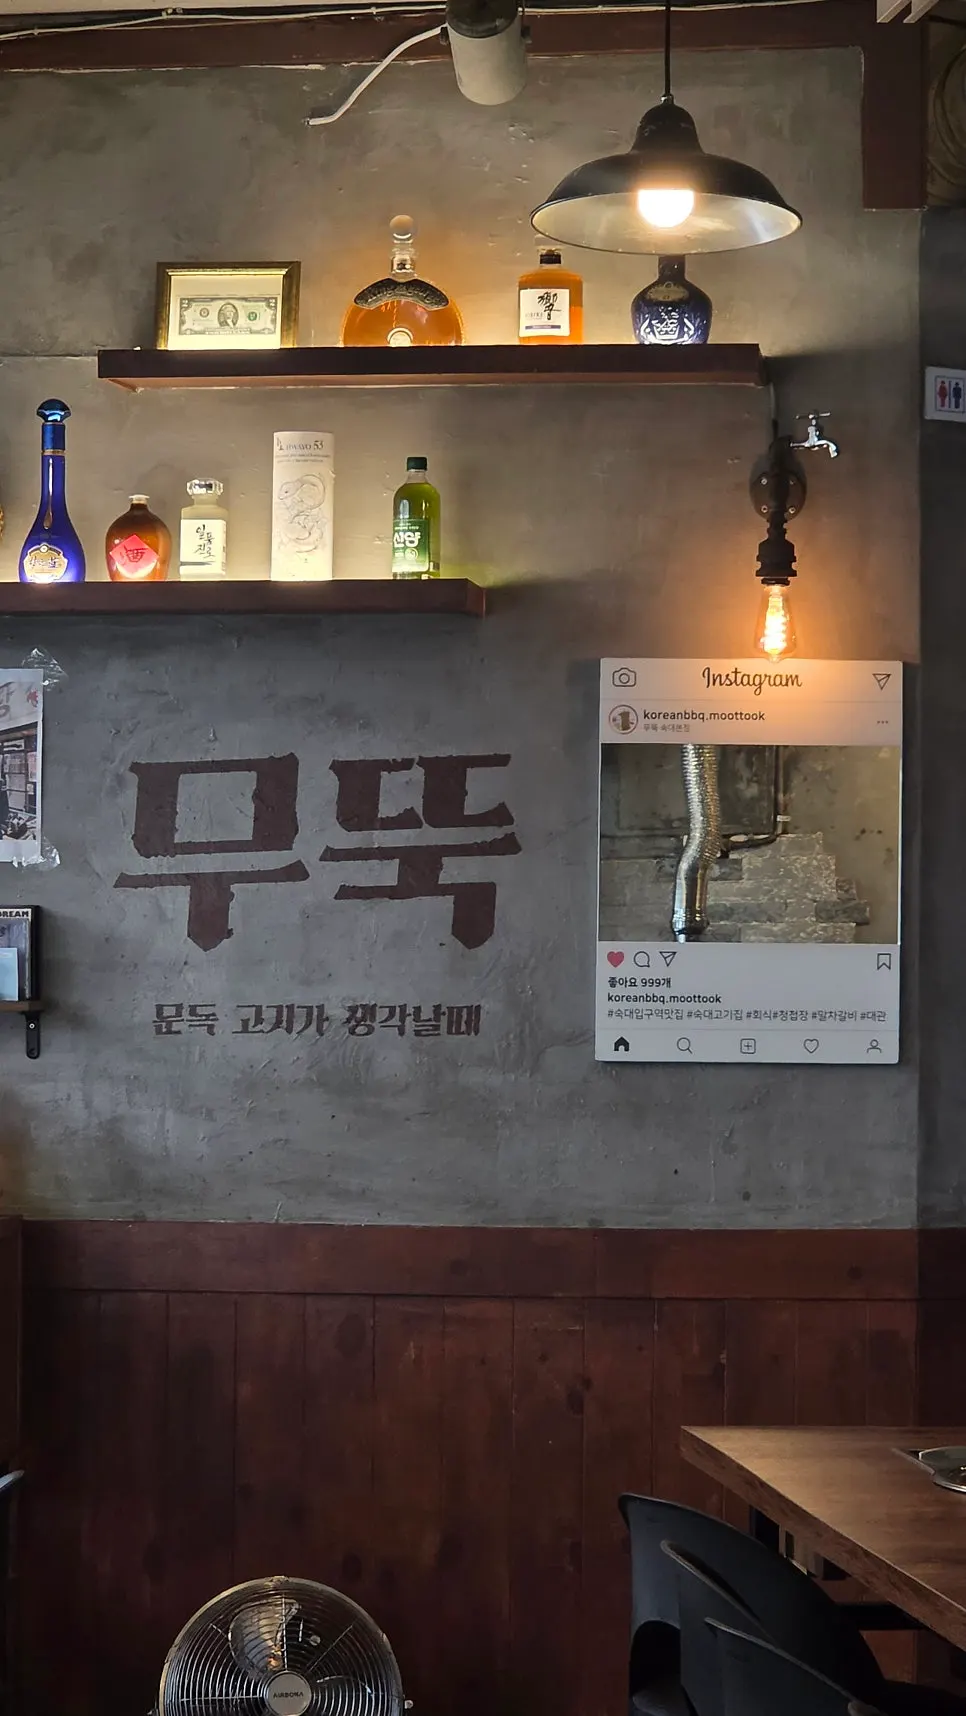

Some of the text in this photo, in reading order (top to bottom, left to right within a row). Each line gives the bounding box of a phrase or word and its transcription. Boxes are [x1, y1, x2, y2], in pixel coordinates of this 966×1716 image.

[701, 667, 803, 696] Instagram
[643, 709, 766, 722] koreanbbq.moottook
[113, 752, 522, 952] 무뚝
[608, 976, 672, 988] 좋아요 999개
[607, 993, 722, 1004] koreanbbq.moottook
[232, 1003, 330, 1036] 고기가
[607, 1008, 684, 1020] #숙대입구역맛집
[686, 1009, 743, 1020] #숙대고기집
[860, 1010, 887, 1021] #대관
